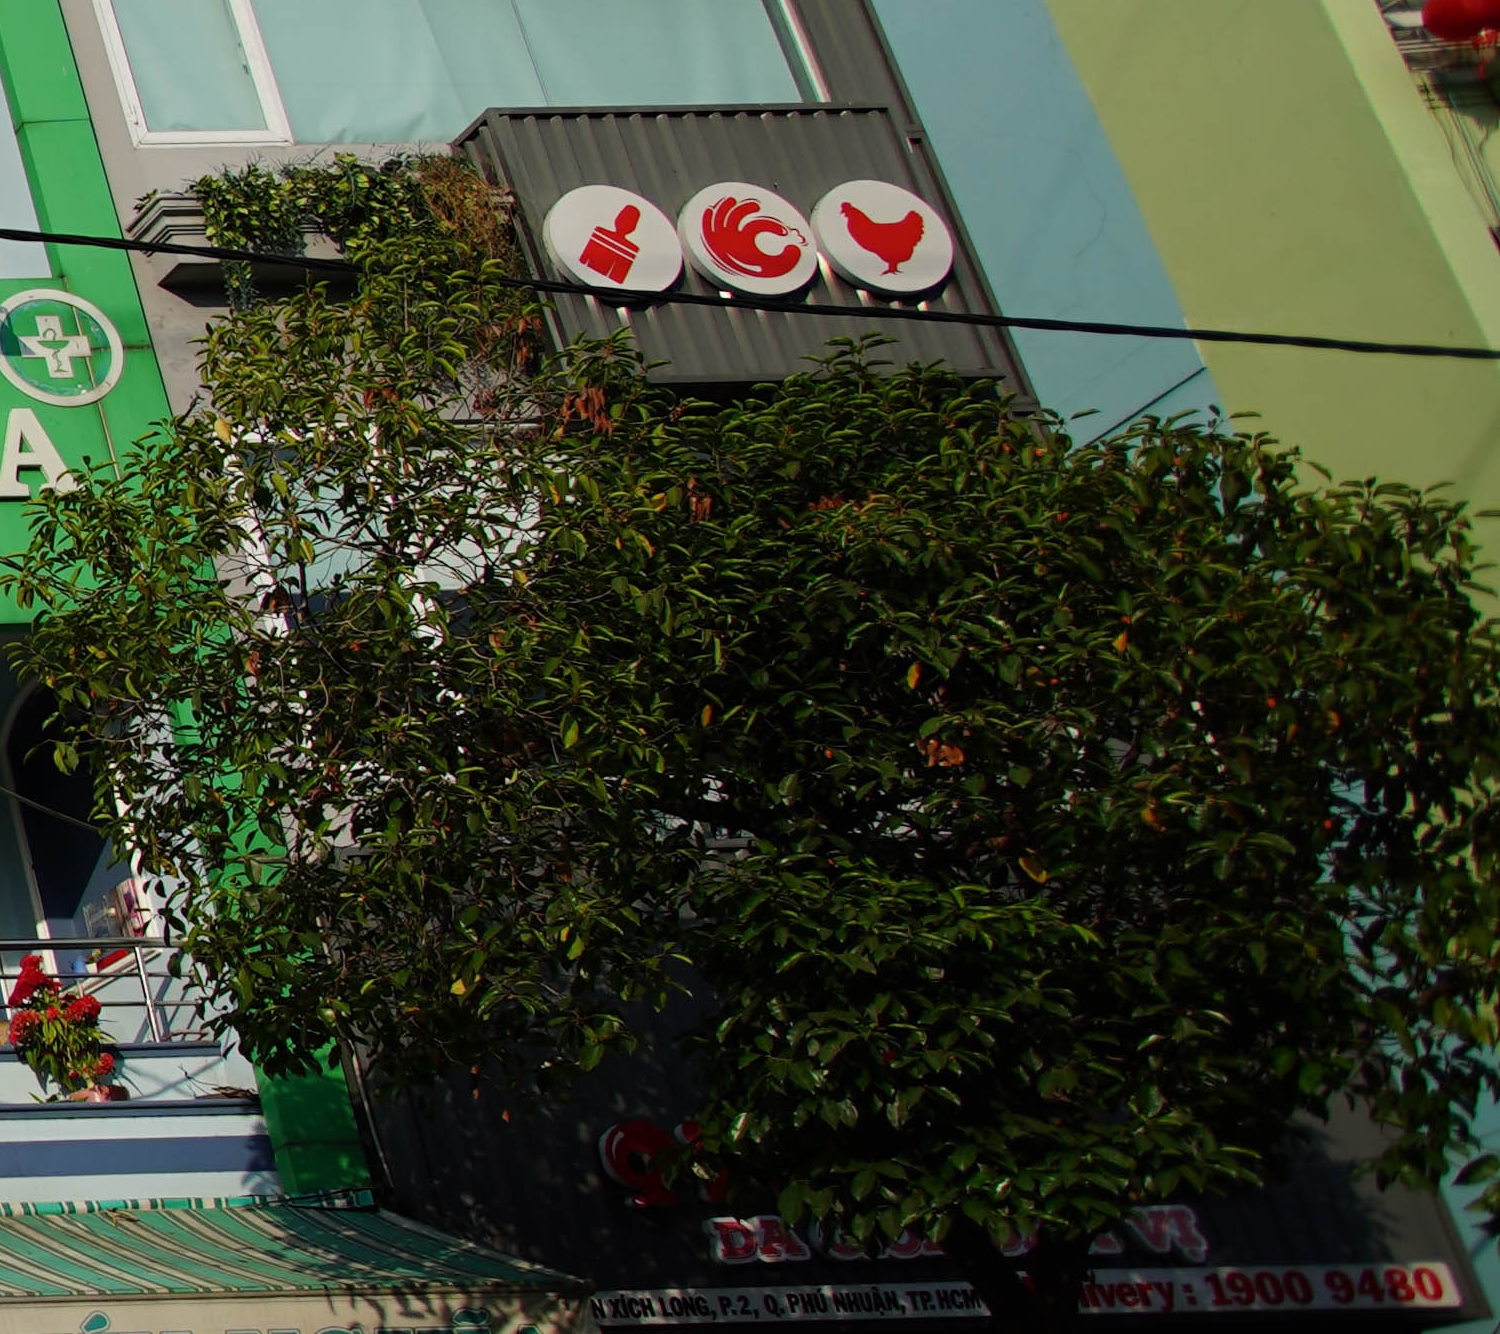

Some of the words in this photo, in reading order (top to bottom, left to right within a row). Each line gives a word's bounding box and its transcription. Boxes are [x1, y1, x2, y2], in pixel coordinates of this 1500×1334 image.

[788, 1285, 828, 1314] PHÚ
[1205, 1270, 1315, 1308] 1900
[1325, 1266, 1444, 1305] 9480
